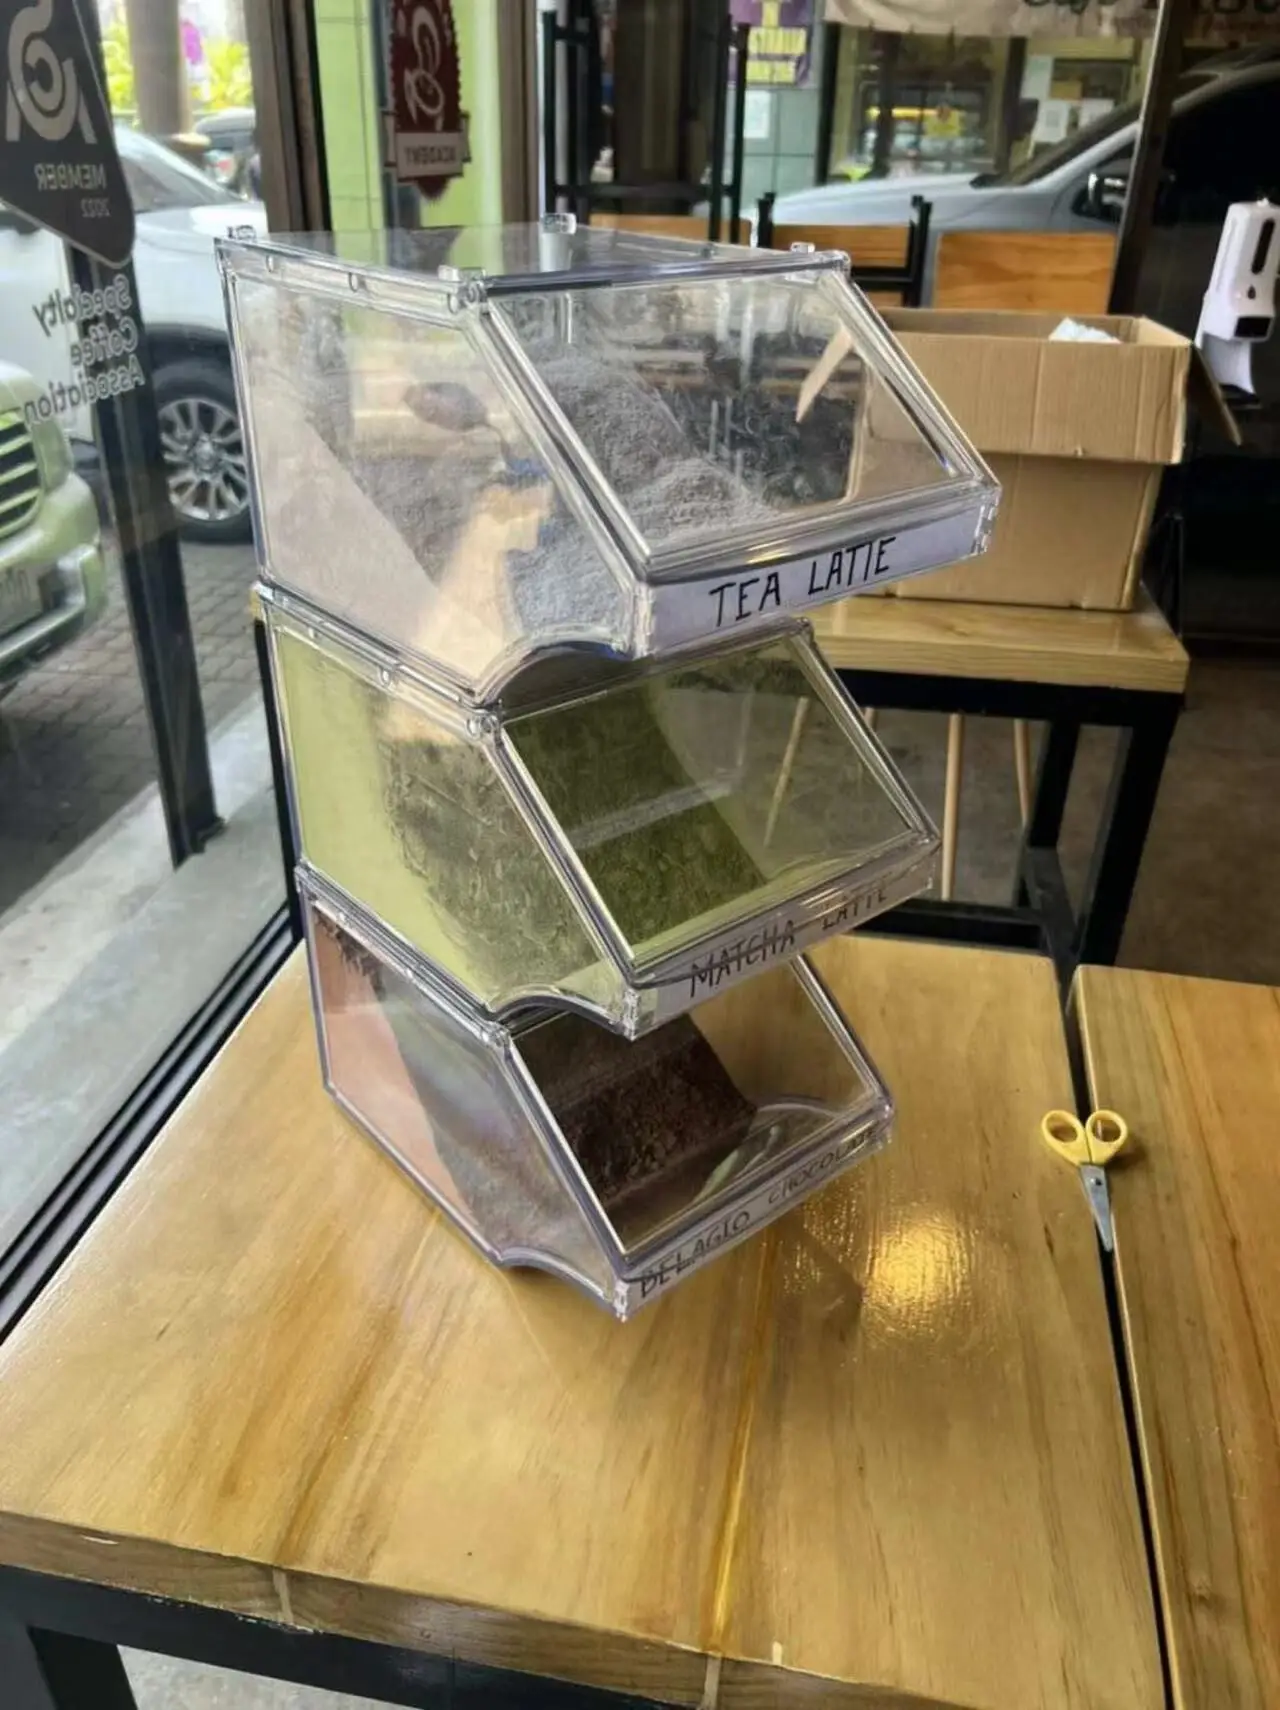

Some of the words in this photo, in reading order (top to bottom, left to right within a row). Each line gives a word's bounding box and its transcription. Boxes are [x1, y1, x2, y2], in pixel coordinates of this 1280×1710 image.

[708, 570, 782, 628] TEA
[806, 536, 897, 596] LATTE
[688, 918, 797, 998] MATCHA
